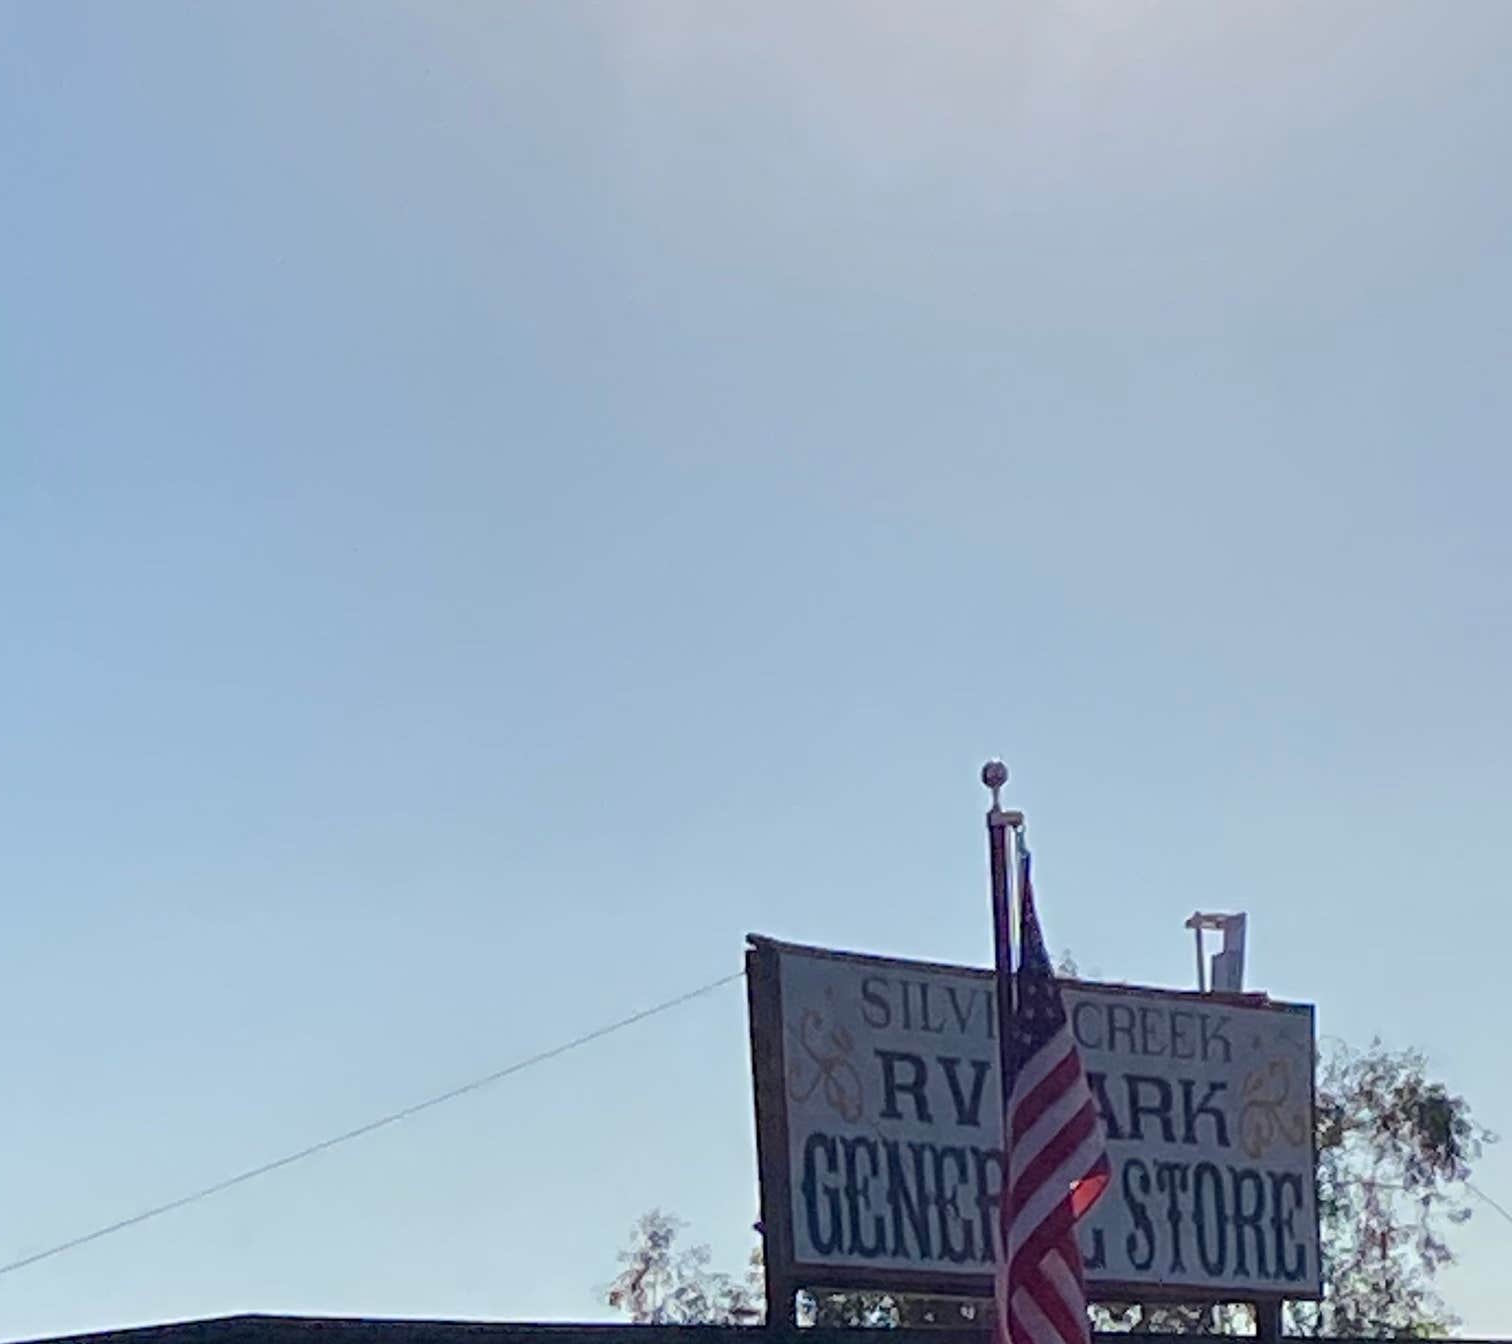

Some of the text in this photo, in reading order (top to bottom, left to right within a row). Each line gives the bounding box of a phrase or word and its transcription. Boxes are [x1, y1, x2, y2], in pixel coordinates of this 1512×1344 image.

[860, 975, 1232, 1063] SILV CREEK
[875, 1048, 1230, 1147] RV ARK
[1122, 1157, 1306, 1281] STORE
